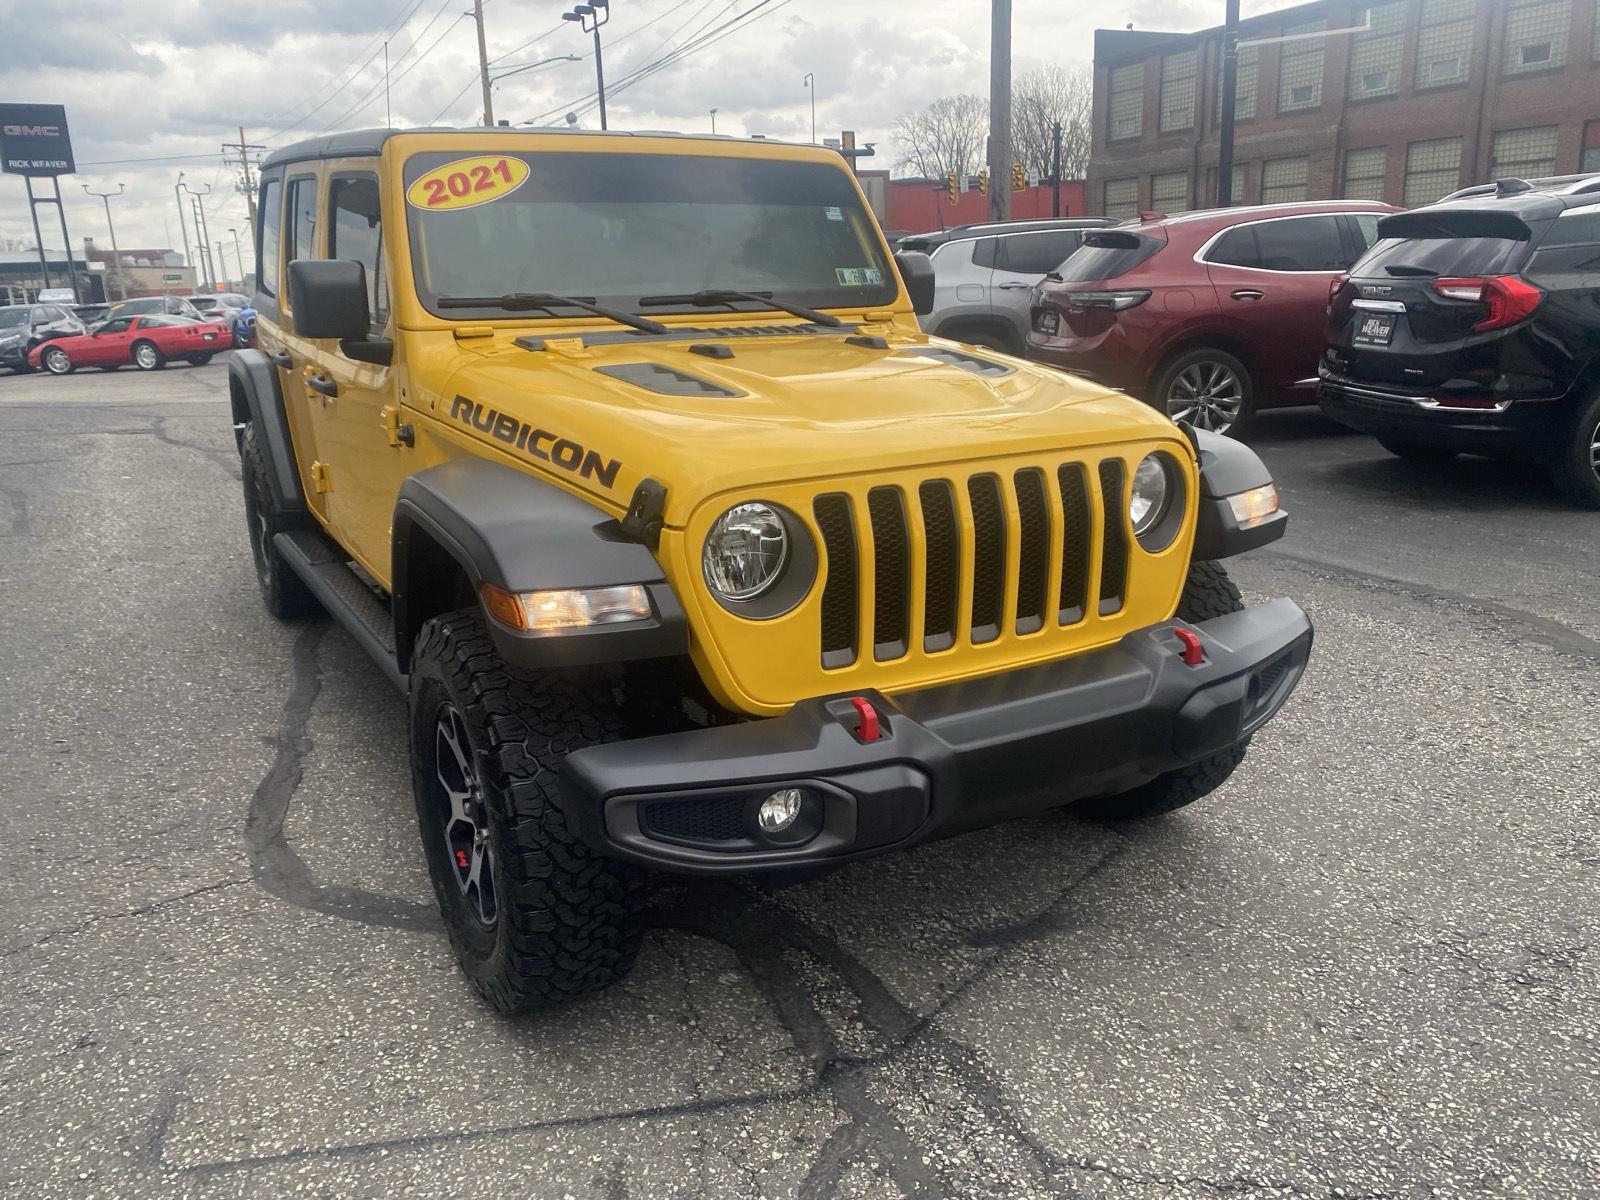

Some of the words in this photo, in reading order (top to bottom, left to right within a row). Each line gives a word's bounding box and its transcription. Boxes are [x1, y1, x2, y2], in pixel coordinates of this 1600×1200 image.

[3, 125, 60, 136] GMC
[8, 160, 31, 168] RICK
[31, 160, 68, 169] WEAVER
[423, 159, 514, 206] 2021
[1361, 286, 1392, 295] GMC
[1361, 325, 1391, 335] WEAVER
[450, 394, 623, 489] RUBICON
